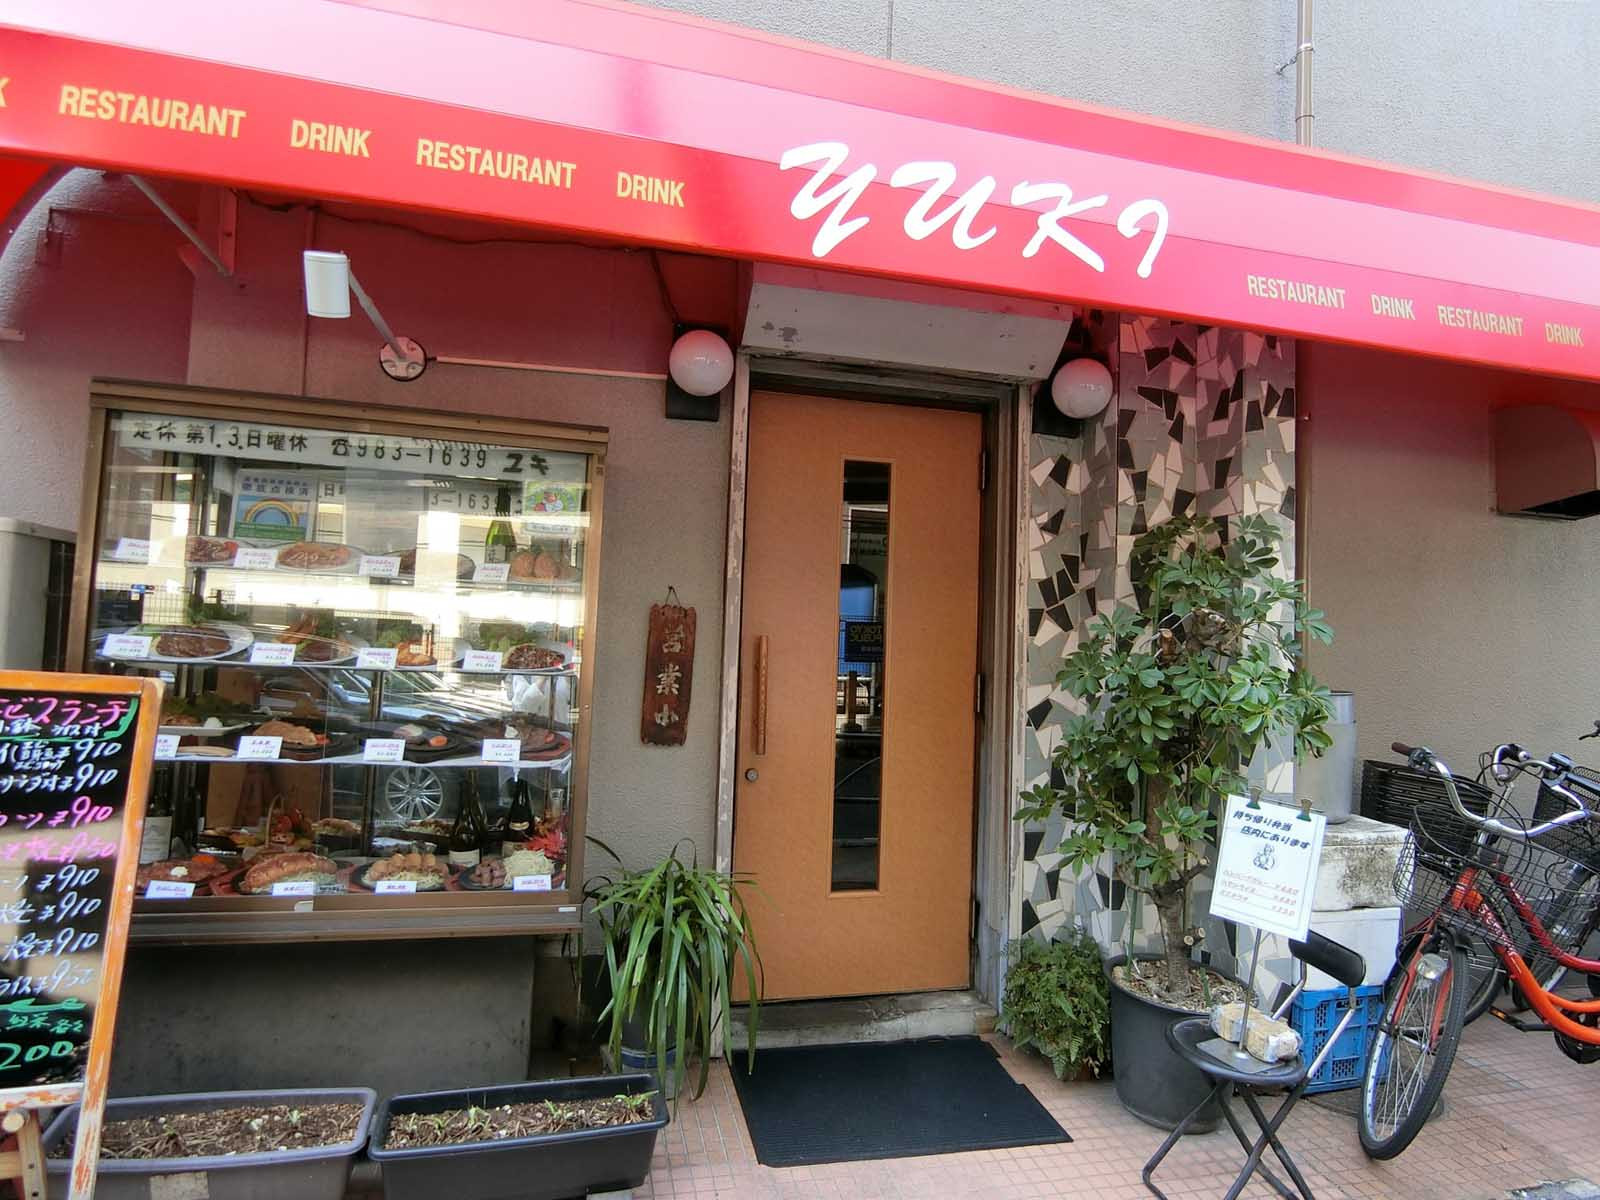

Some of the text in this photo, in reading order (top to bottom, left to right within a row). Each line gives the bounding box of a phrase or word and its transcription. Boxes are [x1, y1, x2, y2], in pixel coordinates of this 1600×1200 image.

[58, 84, 686, 208] RESTAURANT DRINK RESTAURANT DRINK
[779, 141, 1170, 280] YUKI
[1247, 274, 1585, 348] RESTAURANT DRINK RESTAURANT DRINK
[1232, 810, 1293, 832] 持ち帰り弁当
[1240, 825, 1311, 849] 店内にあります
